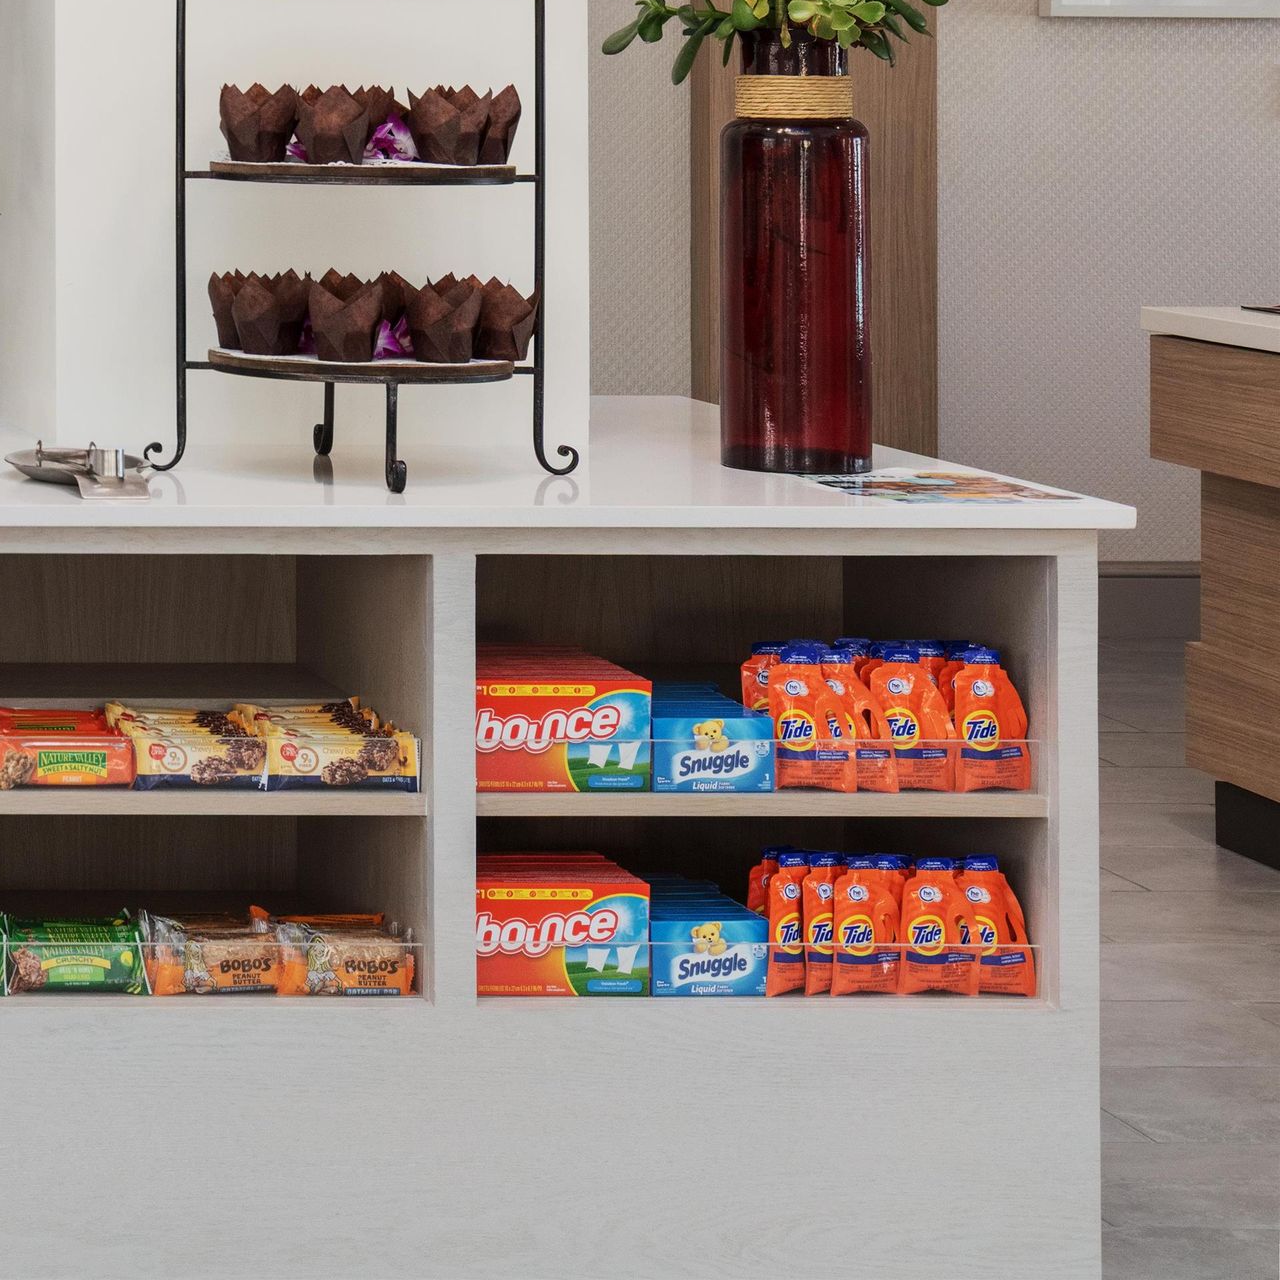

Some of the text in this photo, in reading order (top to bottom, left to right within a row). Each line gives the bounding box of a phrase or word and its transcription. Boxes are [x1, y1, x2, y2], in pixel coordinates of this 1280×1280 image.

[476, 705, 619, 751] bounce
[781, 718, 813, 740] Tide
[967, 719, 997, 741] Tide
[40, 751, 105, 767] NATURE VALLEY
[323, 747, 343, 757] Chewy
[42, 764, 103, 774] SWEET SALTY NUT
[679, 750, 750, 777] Snuggle
[692, 781, 718, 791] Liquid
[476, 908, 617, 955] bounce
[812, 922, 833, 946] Tid
[843, 924, 872, 947] Tide
[912, 923, 942, 946] Tide
[42, 945, 105, 959] NATURE VALLEY
[56, 956, 94, 964] CRUNCHY
[220, 957, 272, 974] BOBO'S
[345, 959, 400, 974] BOBO'S
[678, 952, 747, 980] Snuggle
[691, 984, 716, 994] Liquid
